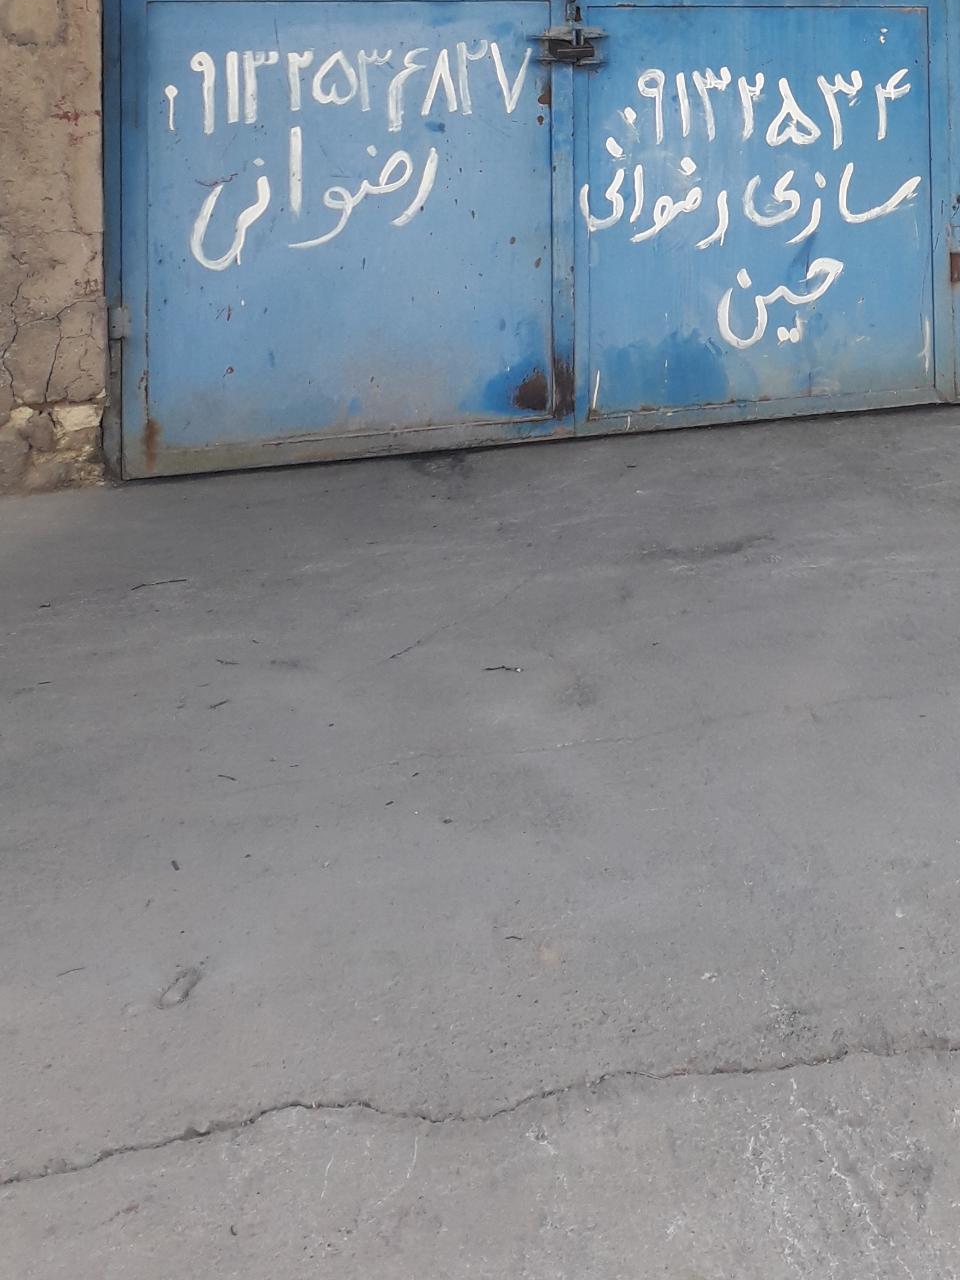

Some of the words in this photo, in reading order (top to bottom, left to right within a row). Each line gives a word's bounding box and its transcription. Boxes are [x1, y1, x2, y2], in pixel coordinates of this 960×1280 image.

[190, 126, 439, 271] رضوانی
[579, 136, 729, 250] رضوانی
[743, 162, 922, 245] سازی
